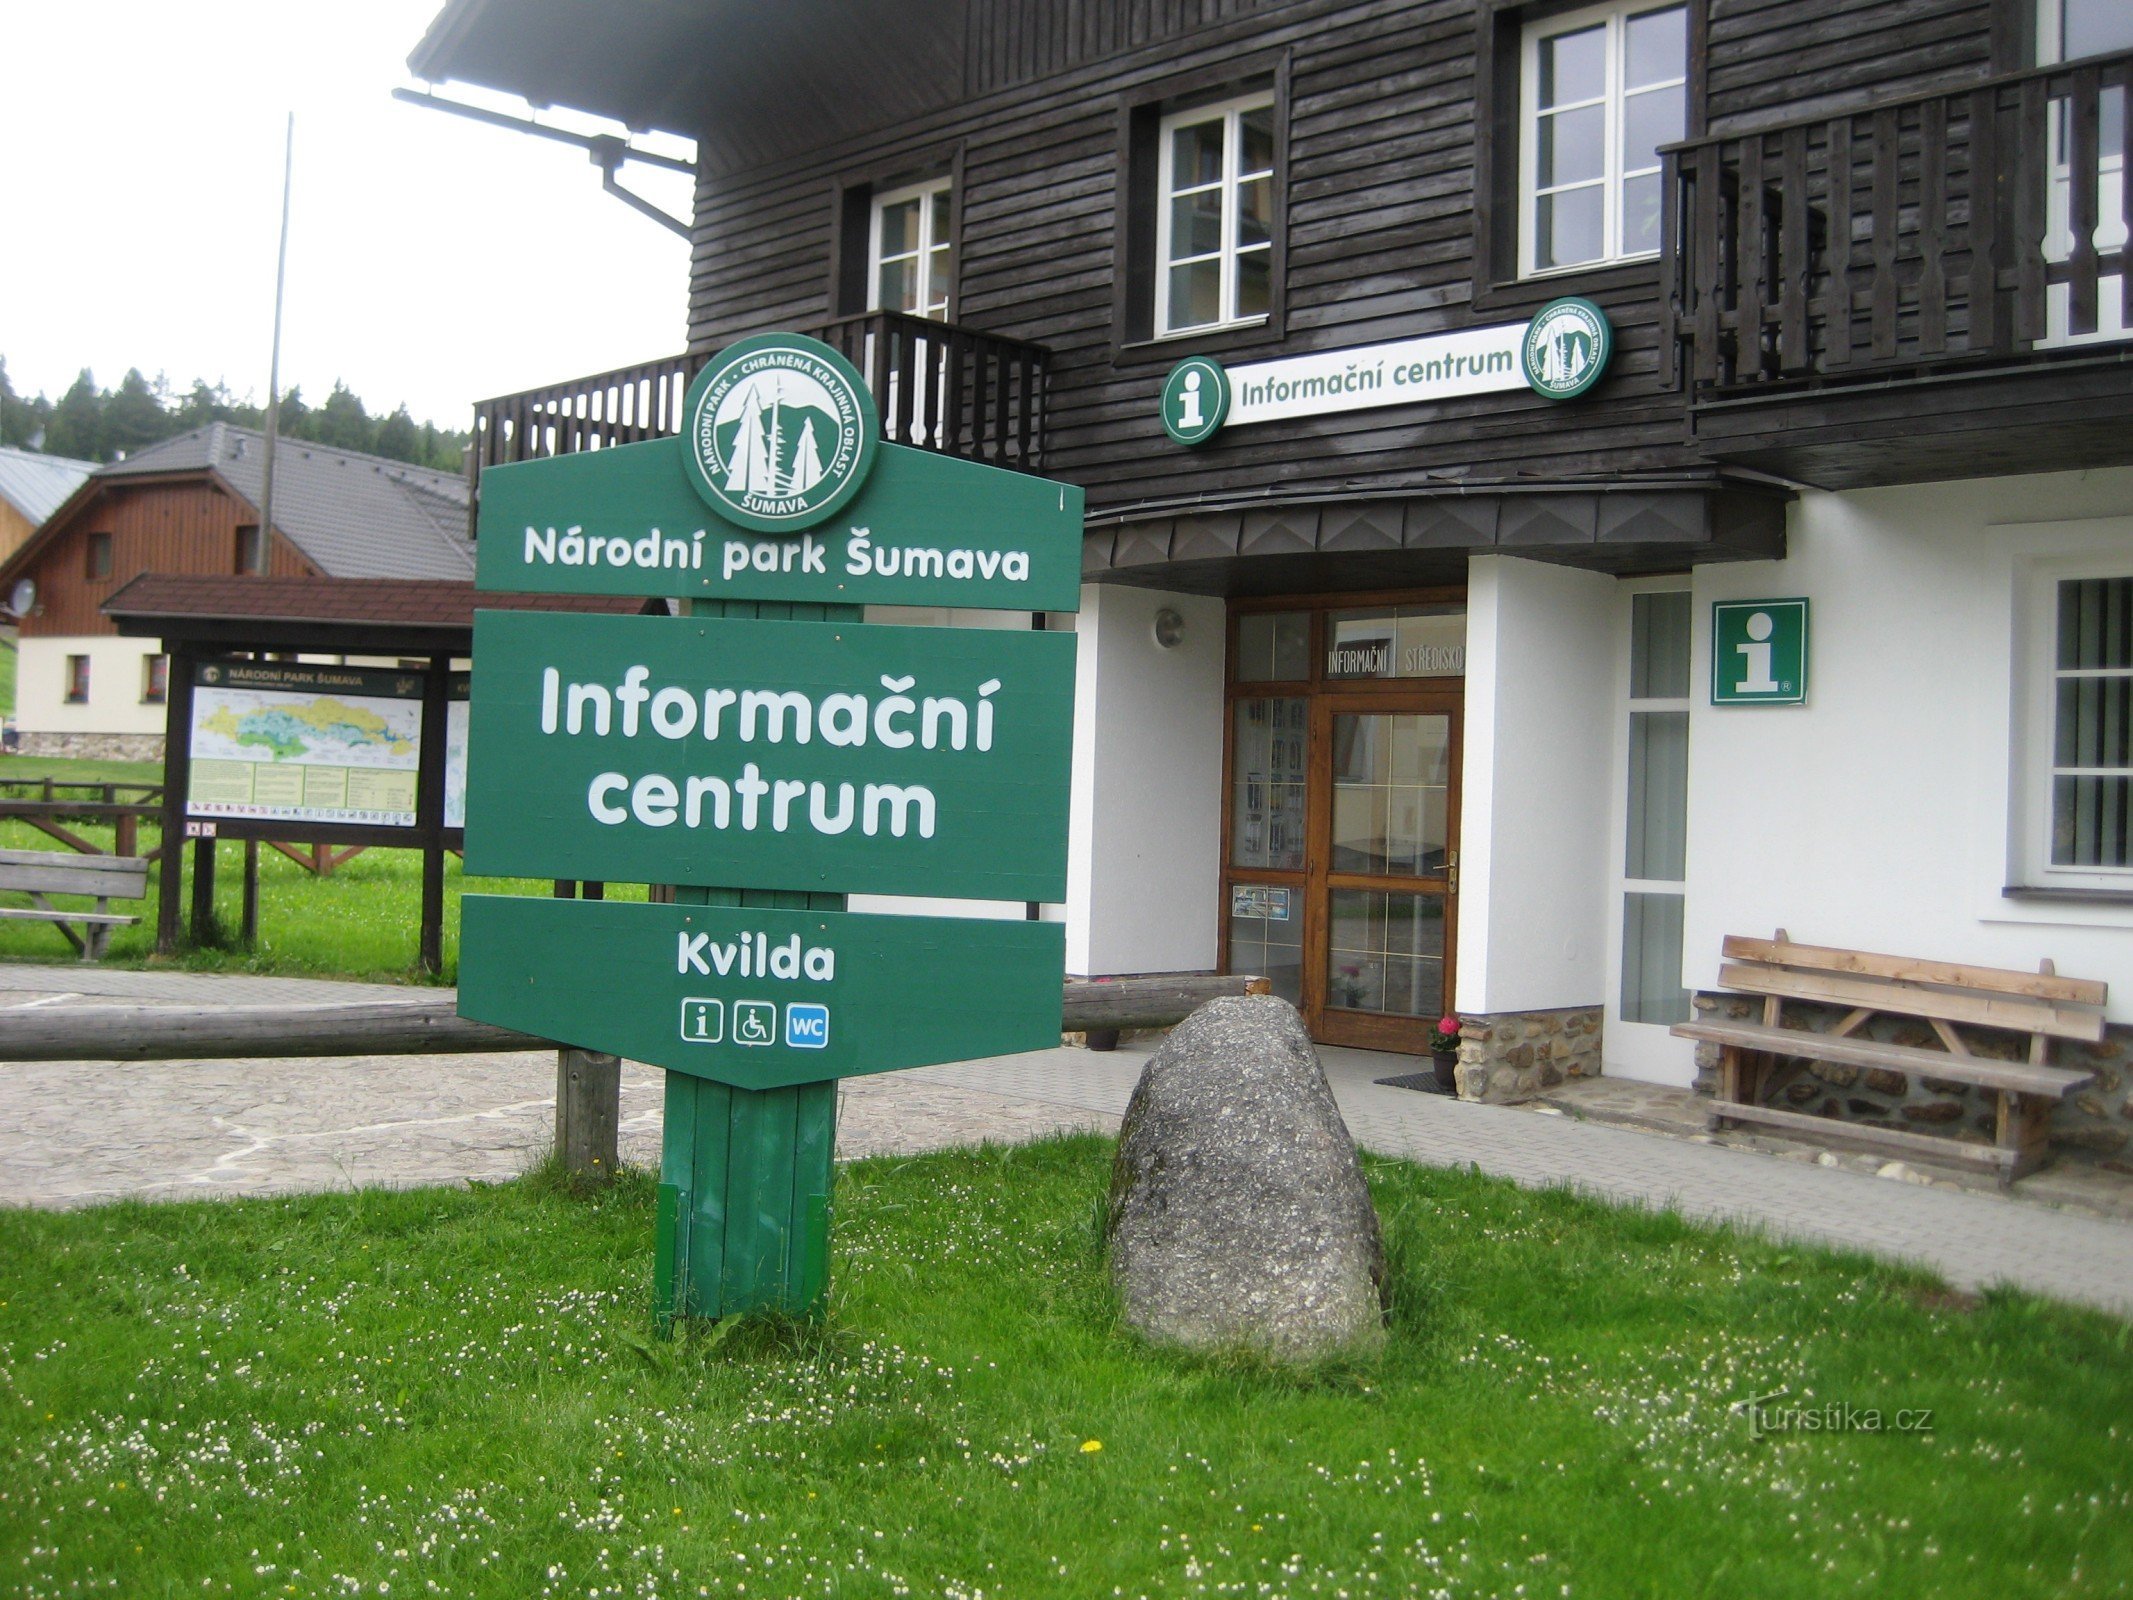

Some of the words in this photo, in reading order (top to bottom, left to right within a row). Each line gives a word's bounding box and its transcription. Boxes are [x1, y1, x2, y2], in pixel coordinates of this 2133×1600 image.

[741, 354, 812, 374] CHRÁNĚNÁ
[1241, 361, 1384, 407] Informační
[1393, 349, 1513, 386] centrum
[1549, 377, 1580, 389] ŠUMAVA
[706, 379, 731, 410] PARK
[812, 366, 856, 425] KRAJINNÁ
[701, 411, 721, 475] NÁRODNÍ
[832, 427, 855, 479] OBLAST
[740, 493, 808, 514] ŠUMAVA
[524, 525, 706, 570] Národní
[722, 534, 827, 580] park
[845, 527, 1030, 582] Šumava
[228, 668, 282, 681] NÁRODNÍ
[283, 671, 314, 683] PARK
[317, 672, 363, 686] ŠUMAVA
[1328, 645, 1388, 674] INFORMAČNÍ
[1405, 645, 1464, 671] STŘEDISKO
[541, 664, 1001, 752] Informační
[587, 762, 937, 839] centrum
[678, 931, 835, 981] Kvilda
[792, 1018, 823, 1037] WC
